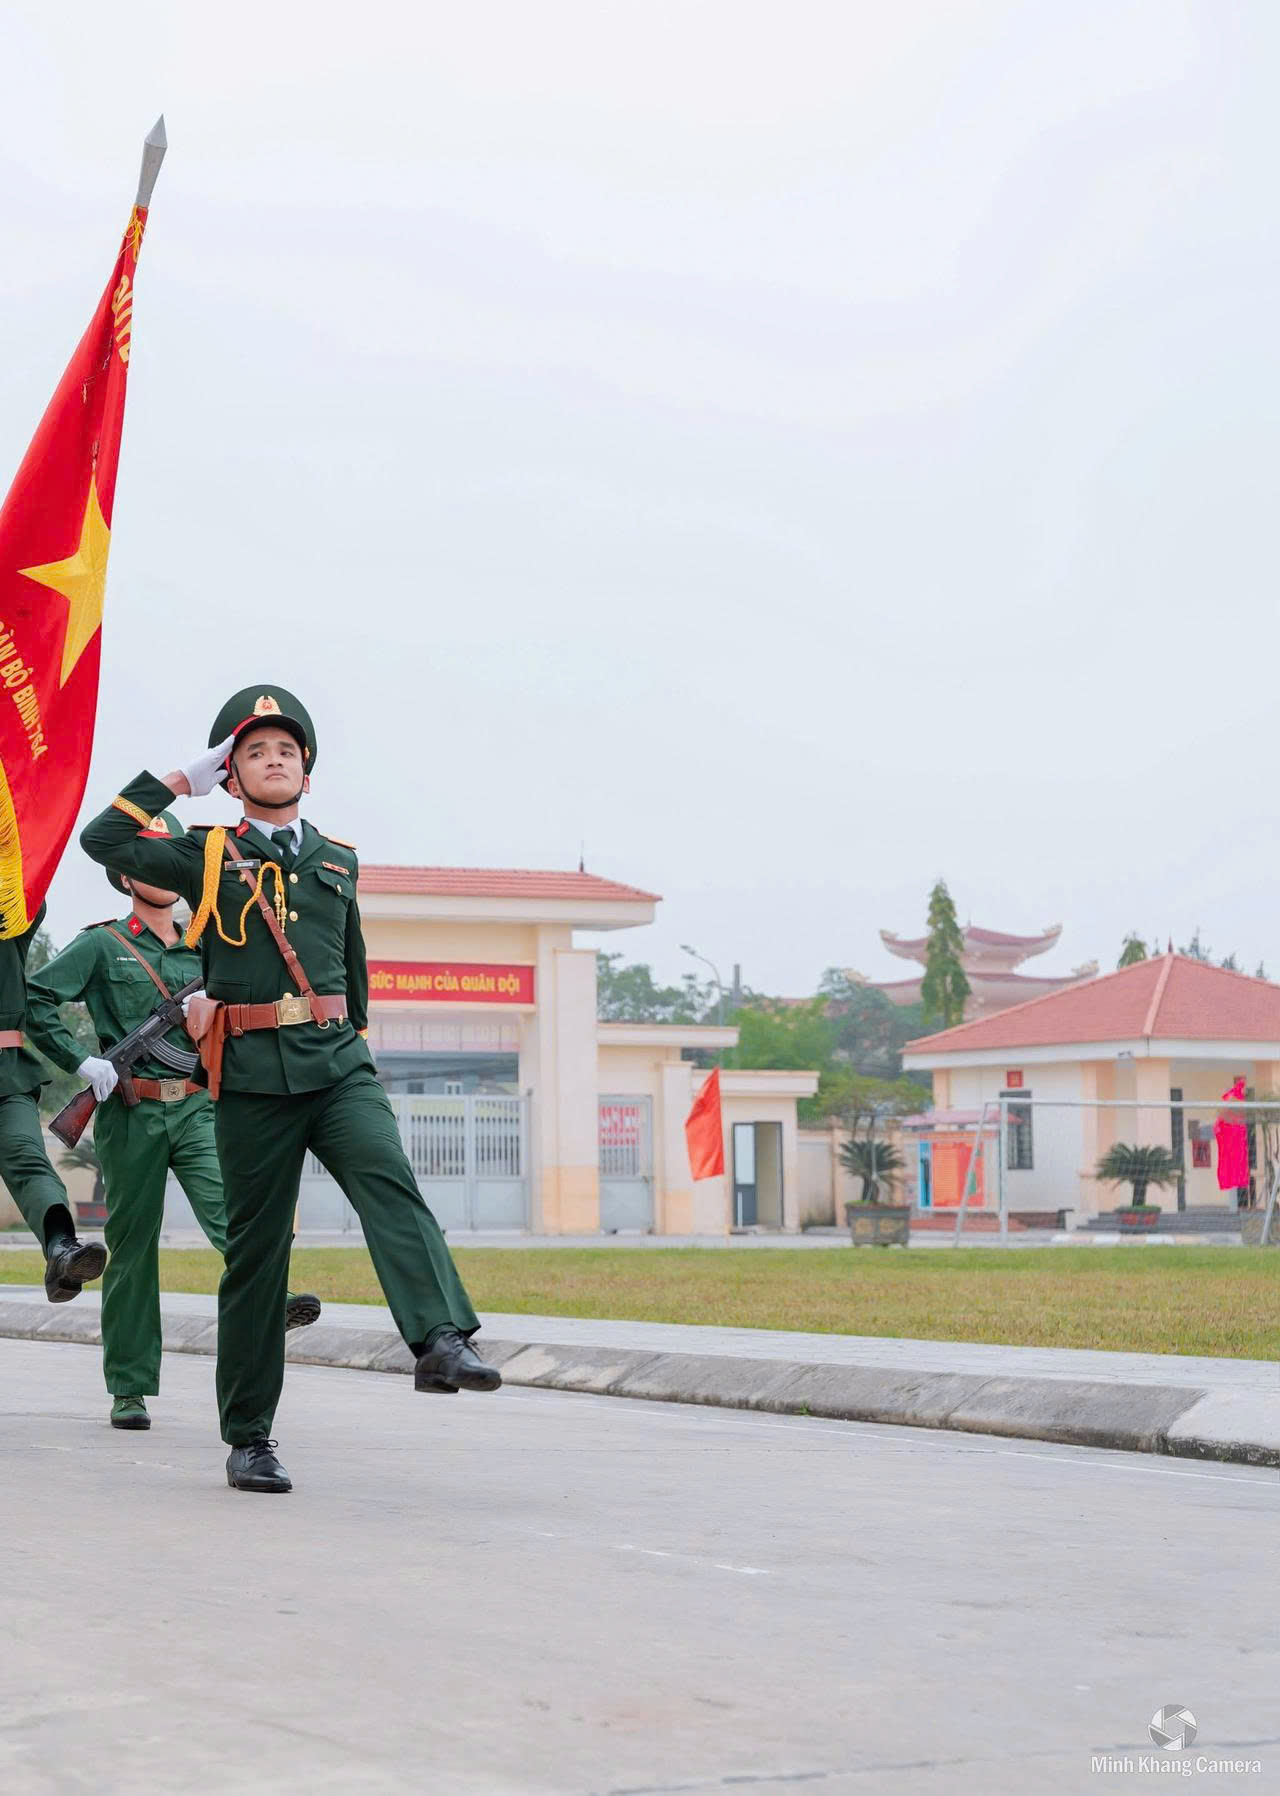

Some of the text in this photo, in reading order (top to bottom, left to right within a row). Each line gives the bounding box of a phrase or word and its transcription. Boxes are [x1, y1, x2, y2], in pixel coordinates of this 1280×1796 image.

[0, 657, 33, 688] BỘ
[12, 684, 40, 731] BINH
[28, 723, 48, 761] 764
[370, 969, 520, 996] SỨC MẠNH CỦA QUÂN ĐỘI
